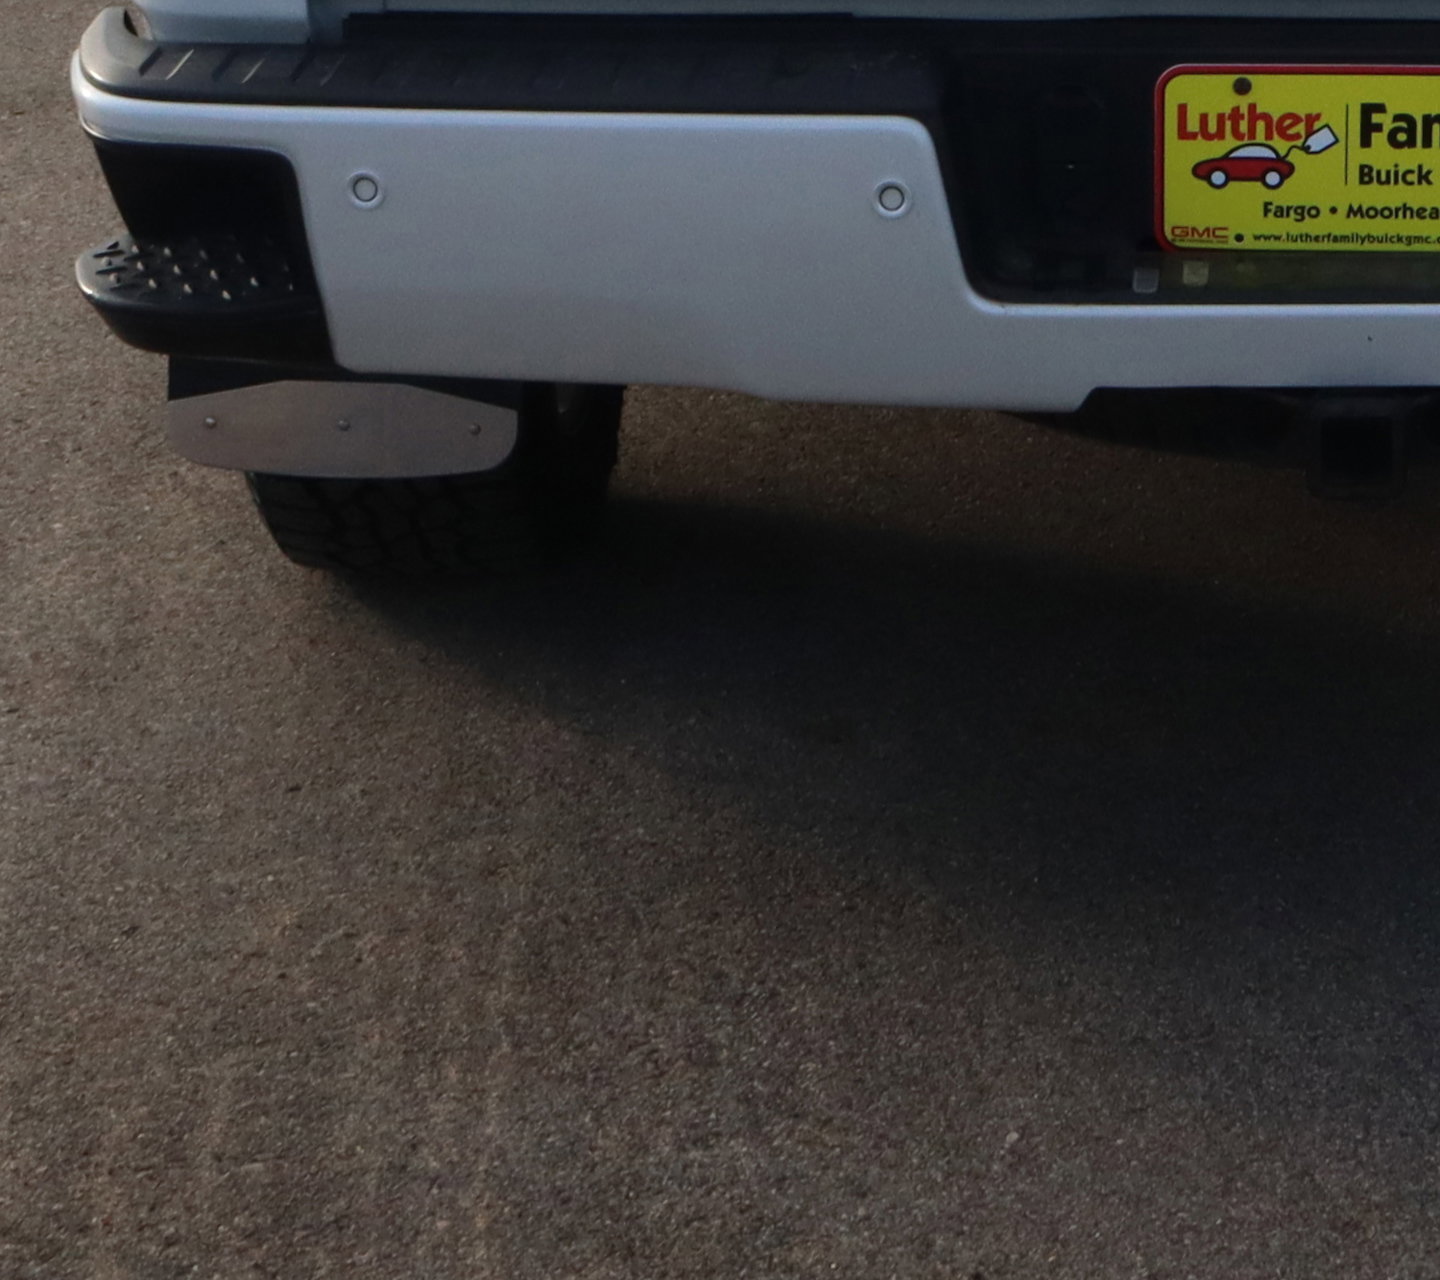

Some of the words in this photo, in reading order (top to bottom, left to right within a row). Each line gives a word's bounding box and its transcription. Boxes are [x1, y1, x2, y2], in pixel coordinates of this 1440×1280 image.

[1176, 102, 1322, 142] Luther
[1359, 163, 1433, 187] Buick
[1263, 201, 1320, 222] Fargo
[1171, 225, 1230, 239] GMC
